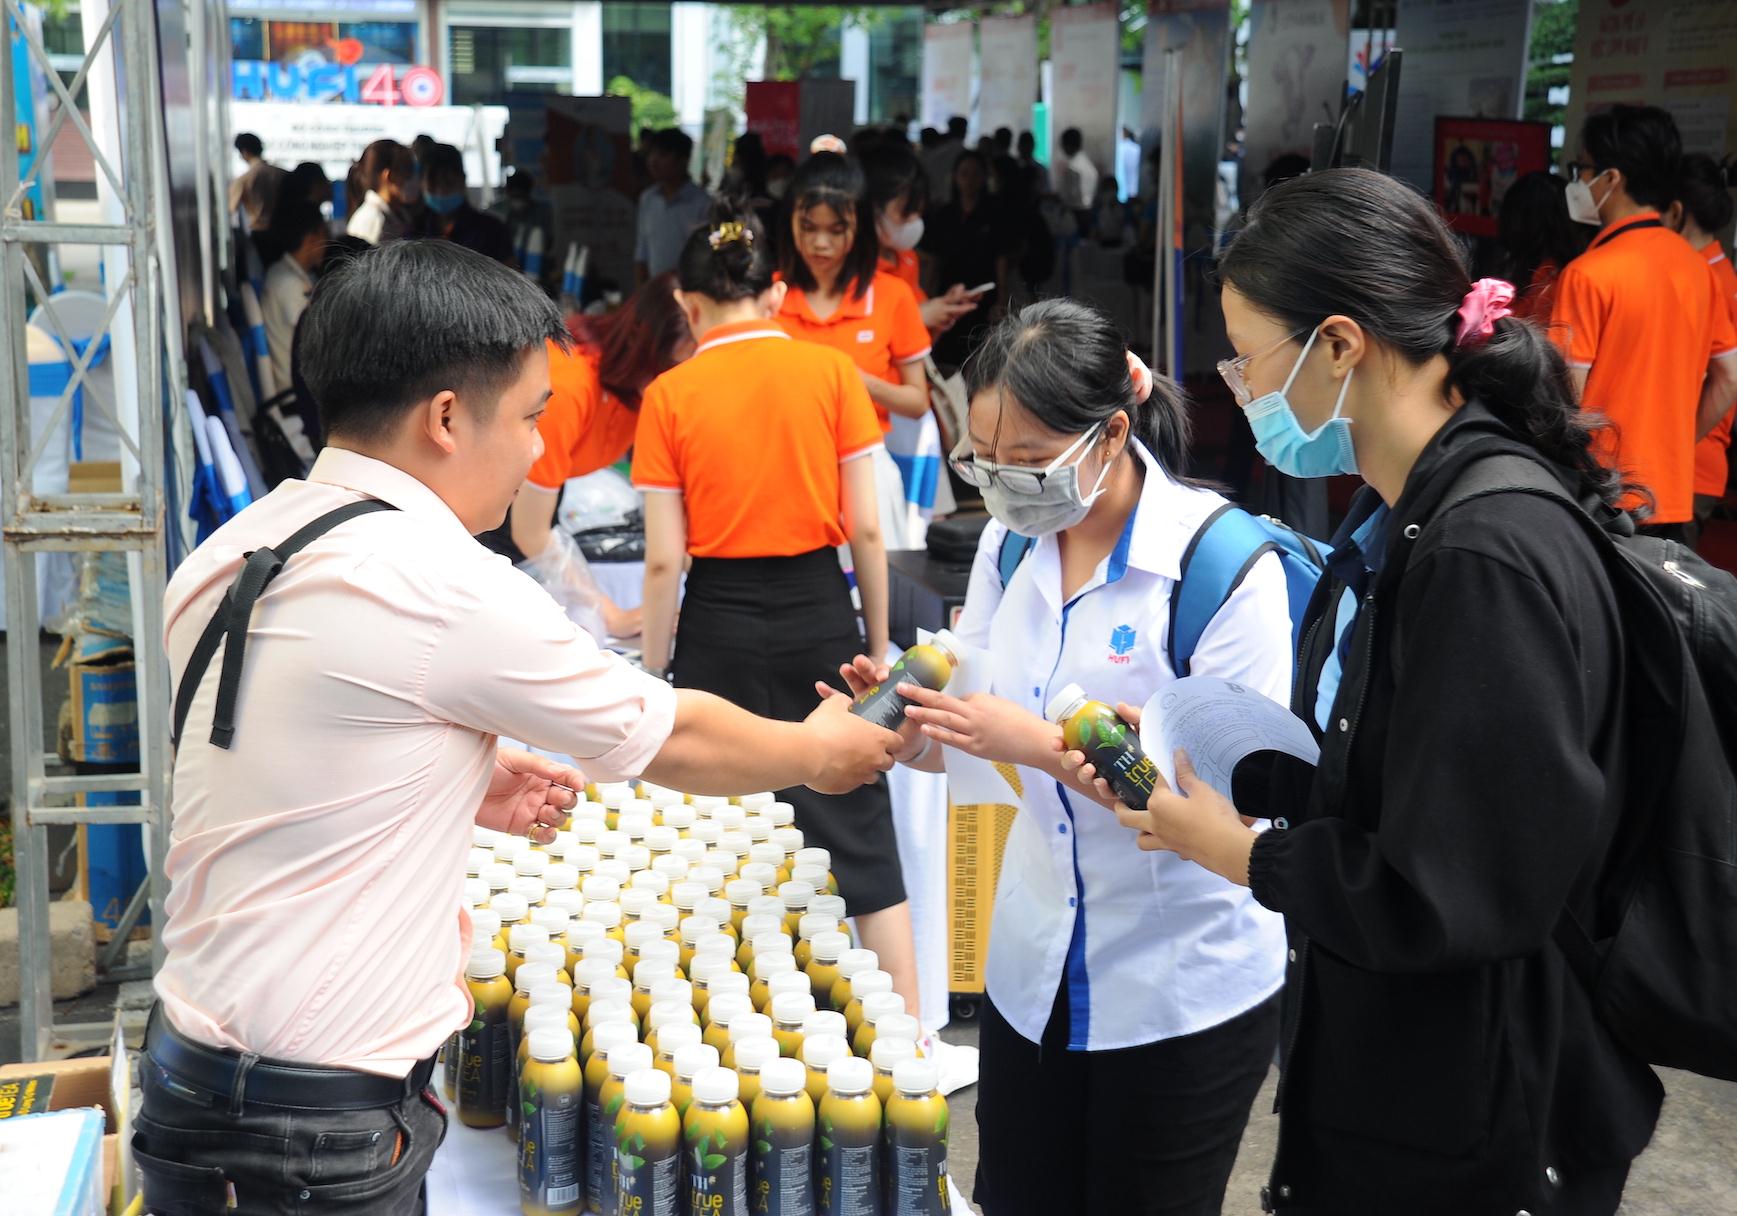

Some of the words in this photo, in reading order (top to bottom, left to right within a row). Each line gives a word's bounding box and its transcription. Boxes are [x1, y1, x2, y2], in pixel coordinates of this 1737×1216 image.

[231, 62, 358, 98] HUFI
[1113, 751, 1136, 771] TH
[1125, 756, 1154, 783] true
[1135, 770, 1158, 794] TE
[691, 1187, 724, 1210] true
